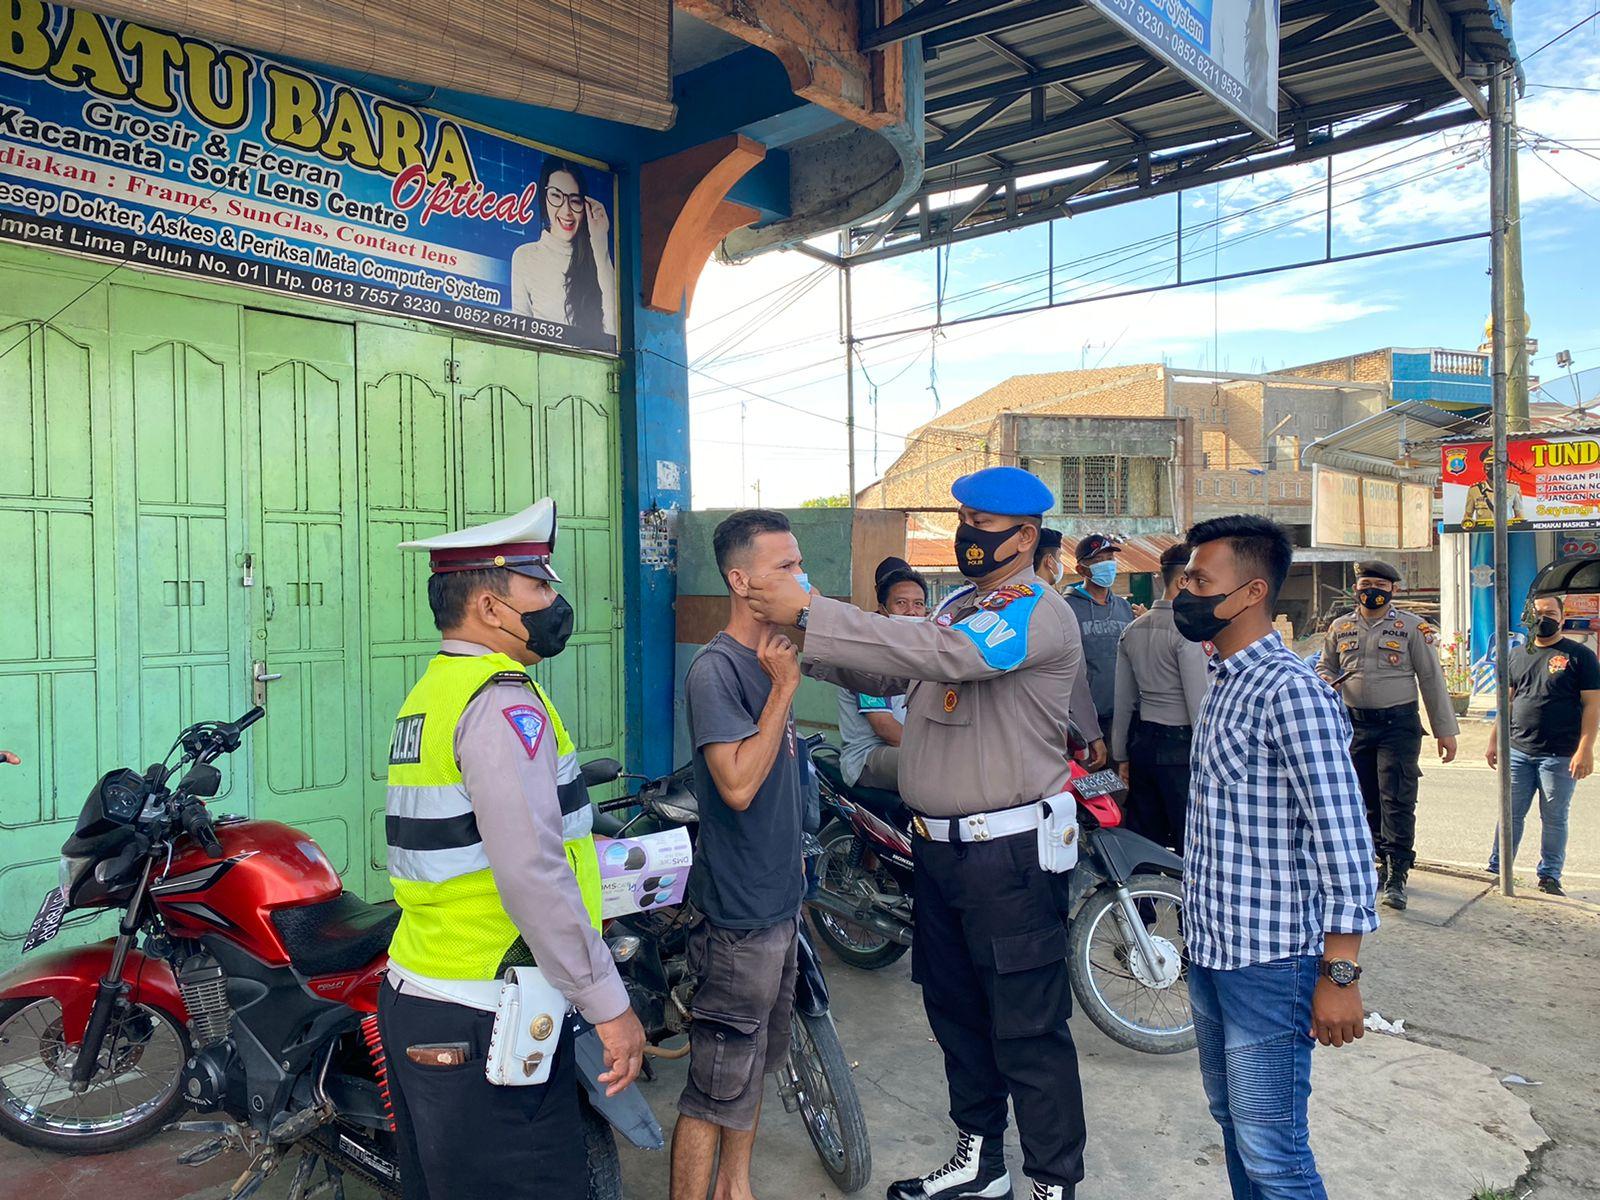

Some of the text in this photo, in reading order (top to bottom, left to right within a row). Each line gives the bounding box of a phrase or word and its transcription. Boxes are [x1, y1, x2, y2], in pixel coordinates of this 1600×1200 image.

[0, 0, 477, 188] BATU BARA
[1137, 6, 1164, 38] 3230
[1171, 33, 1196, 66] 0852
[1197, 55, 1220, 88] 6211
[1221, 75, 1243, 102] 9532
[0, 107, 162, 169] Kacamata
[190, 157, 249, 191] Soft
[257, 174, 319, 207] Lens
[328, 193, 407, 229] Centre
[85, 102, 340, 187] Grosir & Eceran
[125, 175, 218, 214] Frame,
[226, 199, 329, 239] SunGlas,
[336, 226, 417, 256] Contact
[422, 245, 458, 265] lens
[392, 165, 536, 225] Optical
[63, 194, 144, 231] Dokter,
[151, 215, 213, 243] Askes
[220, 229, 235, 247] &
[241, 233, 310, 264] Periksa
[315, 250, 357, 274] Mata
[361, 260, 442, 290] Computer
[445, 276, 500, 304] System
[70, 228, 125, 254] Lima
[133, 240, 192, 267] Puluh
[200, 254, 230, 274] No.
[237, 262, 259, 279] 01
[276, 269, 305, 290] Hp.
[311, 277, 353, 297] 0813
[360, 286, 399, 306] 7557
[403, 295, 441, 314] 3230
[454, 305, 489, 325] 0852
[493, 313, 527, 332] 6211
[531, 321, 564, 339] 9532
[1548, 473, 1585, 481] JANGAN
[1548, 483, 1585, 491] JANGAN
[1548, 493, 1585, 501] JANGAN
[1382, 629, 1408, 638] POLRI
